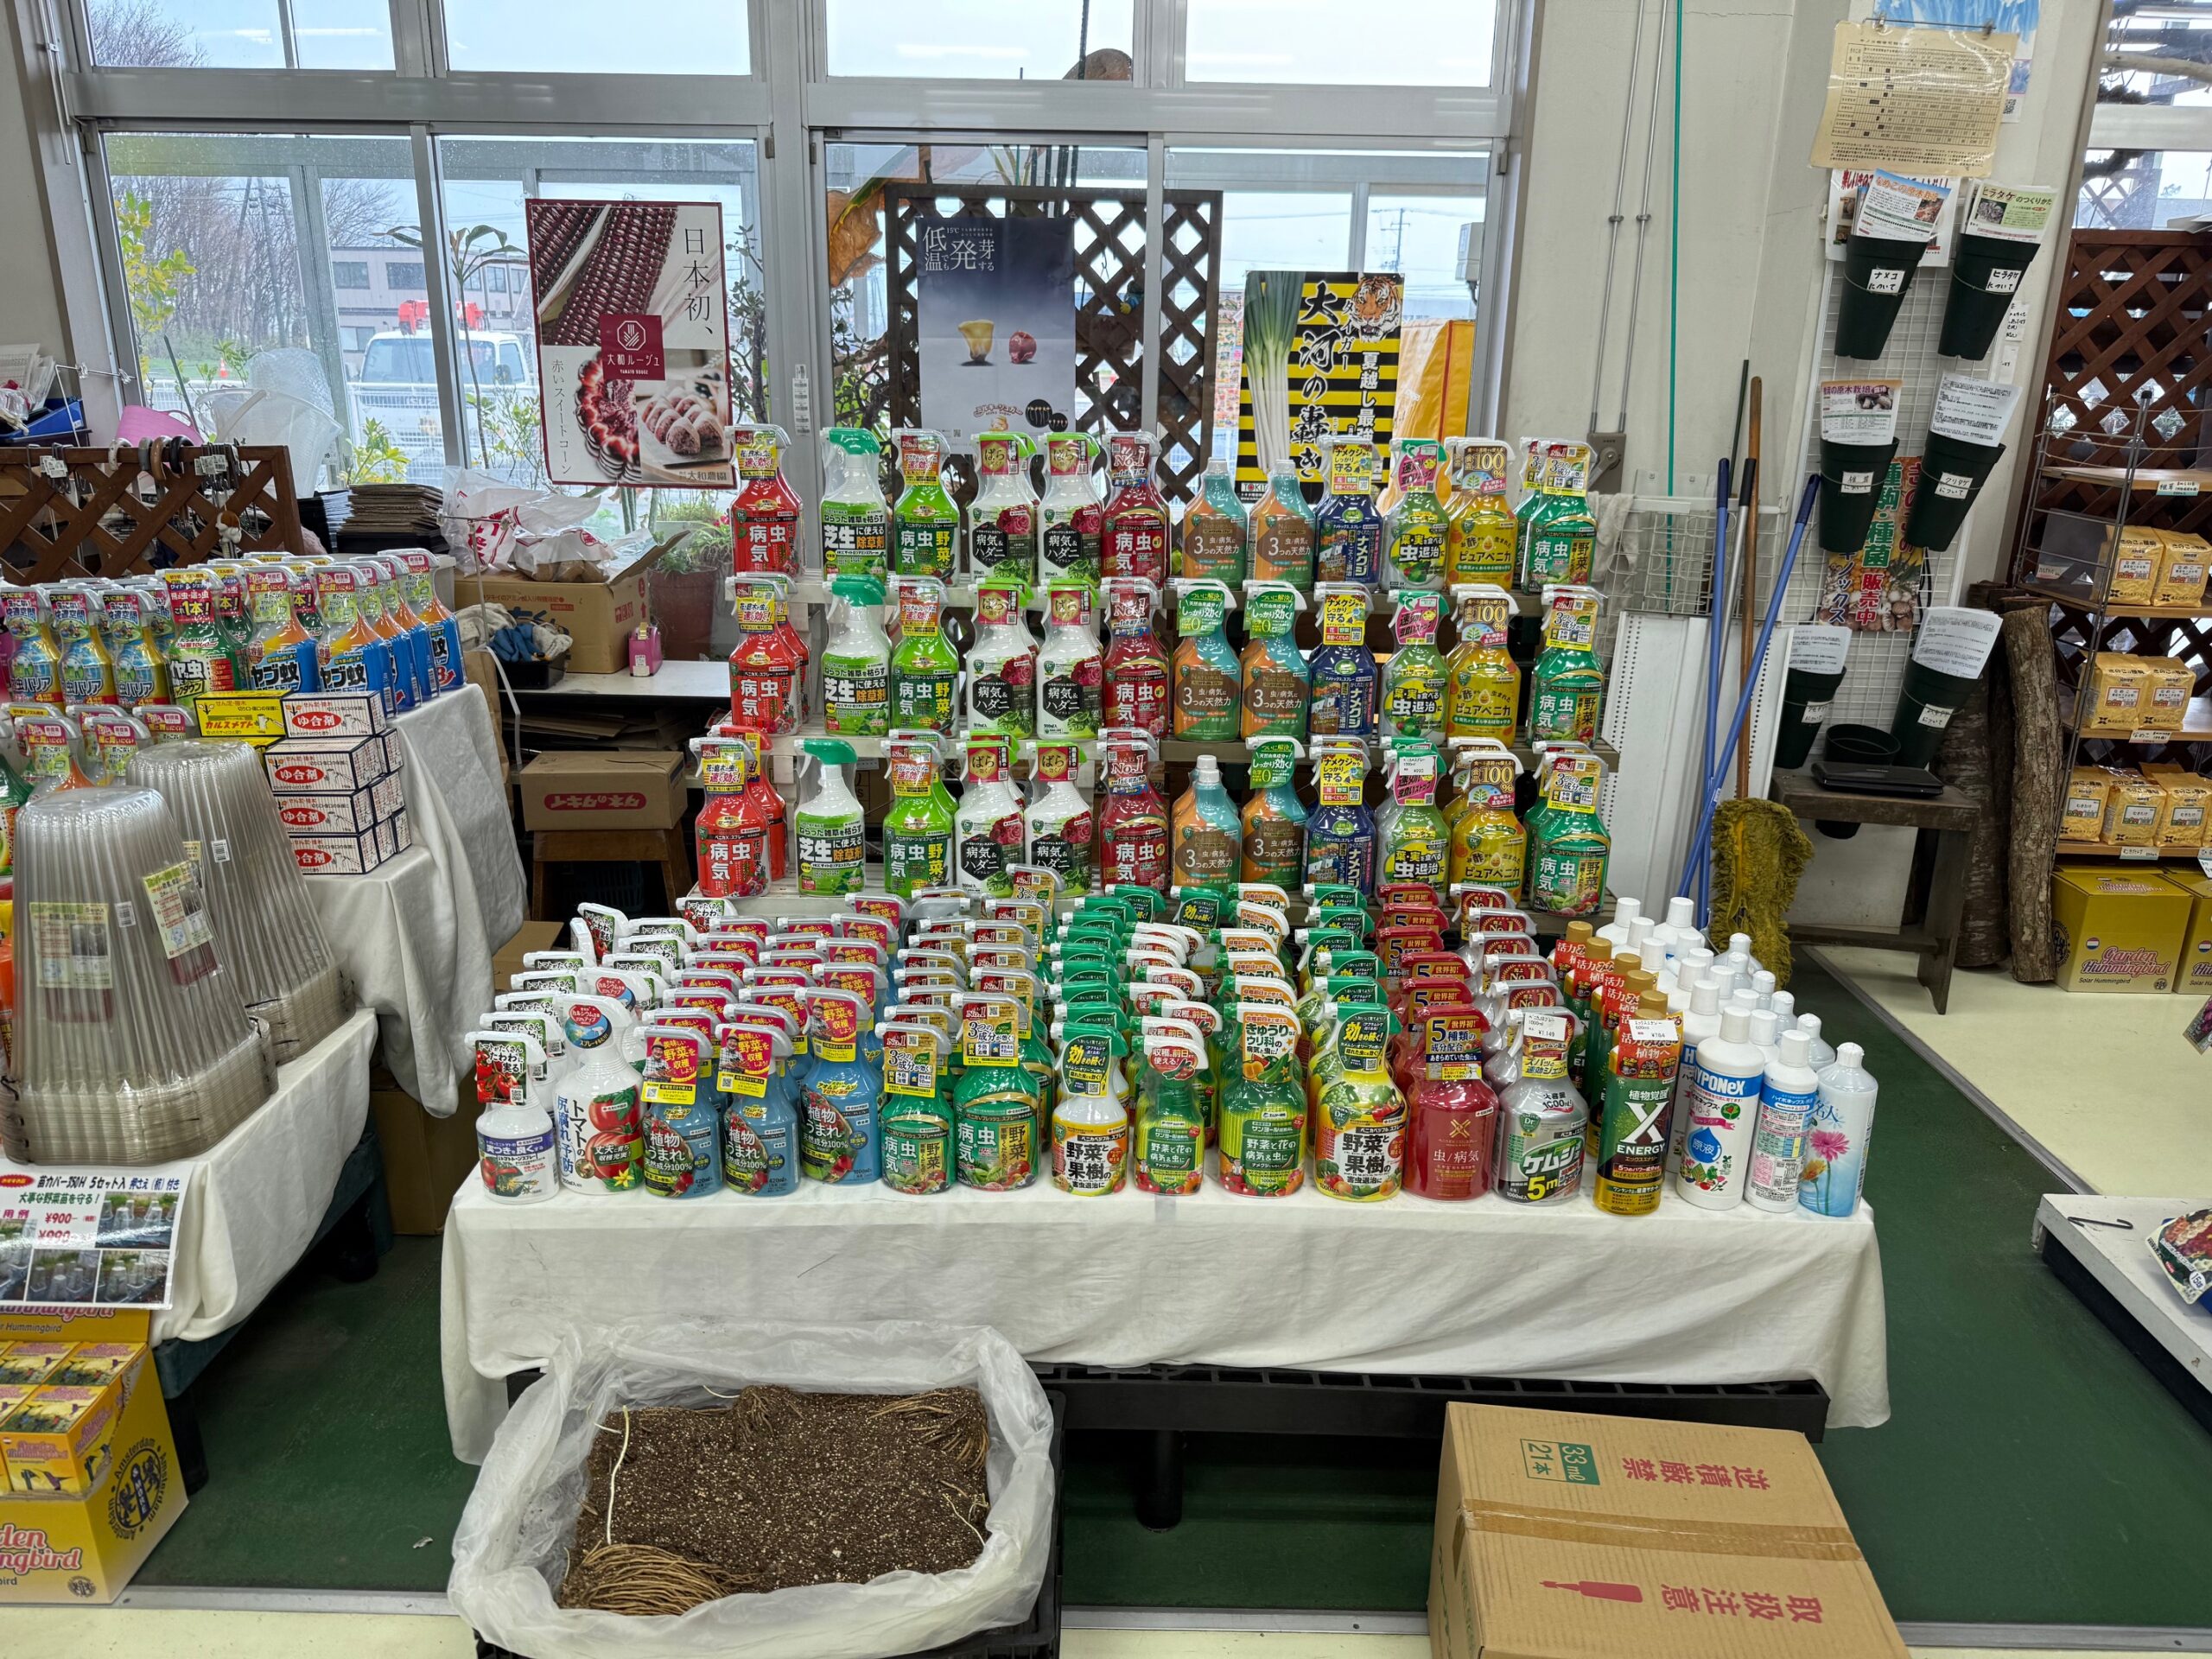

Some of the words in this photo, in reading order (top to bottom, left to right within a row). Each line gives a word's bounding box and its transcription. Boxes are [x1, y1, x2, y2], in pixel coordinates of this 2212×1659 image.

[1874, 271, 1898, 281] ナメコ
[1868, 283, 1897, 291] について
[550, 359, 572, 476] 赤いスイートコーン
[1334, 463, 1353, 473] 守る
[823, 525, 855, 550] 芝生
[856, 527, 885, 536] に使える
[856, 537, 885, 549] 除草剤
[936, 531, 950, 562] 野菜
[976, 547, 1006, 558] ハダニ
[1046, 547, 1079, 558] ハダニ
[1356, 537, 1369, 576] ナメクジ
[1459, 551, 1511, 562] ピュアベニカ
[1578, 542, 1590, 569] 野菜
[1858, 573, 1884, 626] 販売中
[1326, 613, 1345, 623] 守る
[760, 679, 779, 697] 虫
[824, 677, 855, 702] 芝生
[856, 680, 886, 689] に使える
[856, 690, 886, 702] 除草剤
[936, 682, 950, 714] 野菜
[976, 700, 1009, 710] ハダニ
[1348, 688, 1362, 728] ナメクジ
[1456, 706, 1510, 716] ピュアベニカ
[1582, 696, 1593, 724] 野菜
[296, 714, 335, 728] ゆ合剤
[972, 755, 995, 768] ばら
[1041, 755, 1065, 768] ばら
[1253, 759, 1293, 770] しっかり効く!
[280, 769, 318, 780] ゆ合剤
[1324, 772, 1343, 783] 守る
[283, 810, 321, 823] ゆ合剤
[798, 838, 832, 862] 芝生
[834, 849, 862, 861] 除草剤
[1139, 844, 1156, 861] 虫
[964, 861, 1000, 869] ハダニ
[1465, 866, 1520, 877] ピュアベニカ
[1560, 861, 1575, 876] 虫
[2102, 946, 2158, 963] Garden
[2081, 960, 2171, 977] Hummingbird
[1452, 1020, 1476, 1029] 世界初!
[739, 1039, 769, 1052] 野菜を
[1247, 1036, 1282, 1047] ウリ科の
[664, 1048, 695, 1060] 野菜を
[1636, 1050, 1669, 1058] 植物へ
[503, 1062, 523, 1073] 実る!
[672, 1059, 690, 1069] 収穫
[1629, 1089, 1669, 1100] 植物覚醒
[808, 1106, 836, 1124] 植物
[570, 1100, 588, 1157] トマトの
[1619, 1101, 1669, 1144] X
[806, 1123, 842, 1138] うまれ
[650, 1133, 681, 1146] 植物
[977, 1128, 996, 1147] 虫
[1008, 1125, 1026, 1160] 野菜
[1246, 1139, 1296, 1149] 野菜と花の
[1343, 1134, 1389, 1153] 野菜と
[1066, 1141, 1109, 1161] 野菜と
[1151, 1142, 1192, 1154] 野菜と花の
[1617, 1144, 1665, 1155] ENERGY
[1692, 1138, 1714, 1155] 原液
[1068, 1163, 1112, 1179] 果樹の
[1344, 1156, 1390, 1173] 果樹の
[6, 1322, 62, 1333] Hummingbird
[115, 1438, 156, 1479] Amsterdam
[1621, 1456, 1771, 1491] 逆積厳禁
[1661, 1582, 1824, 1624] 取扱注意
